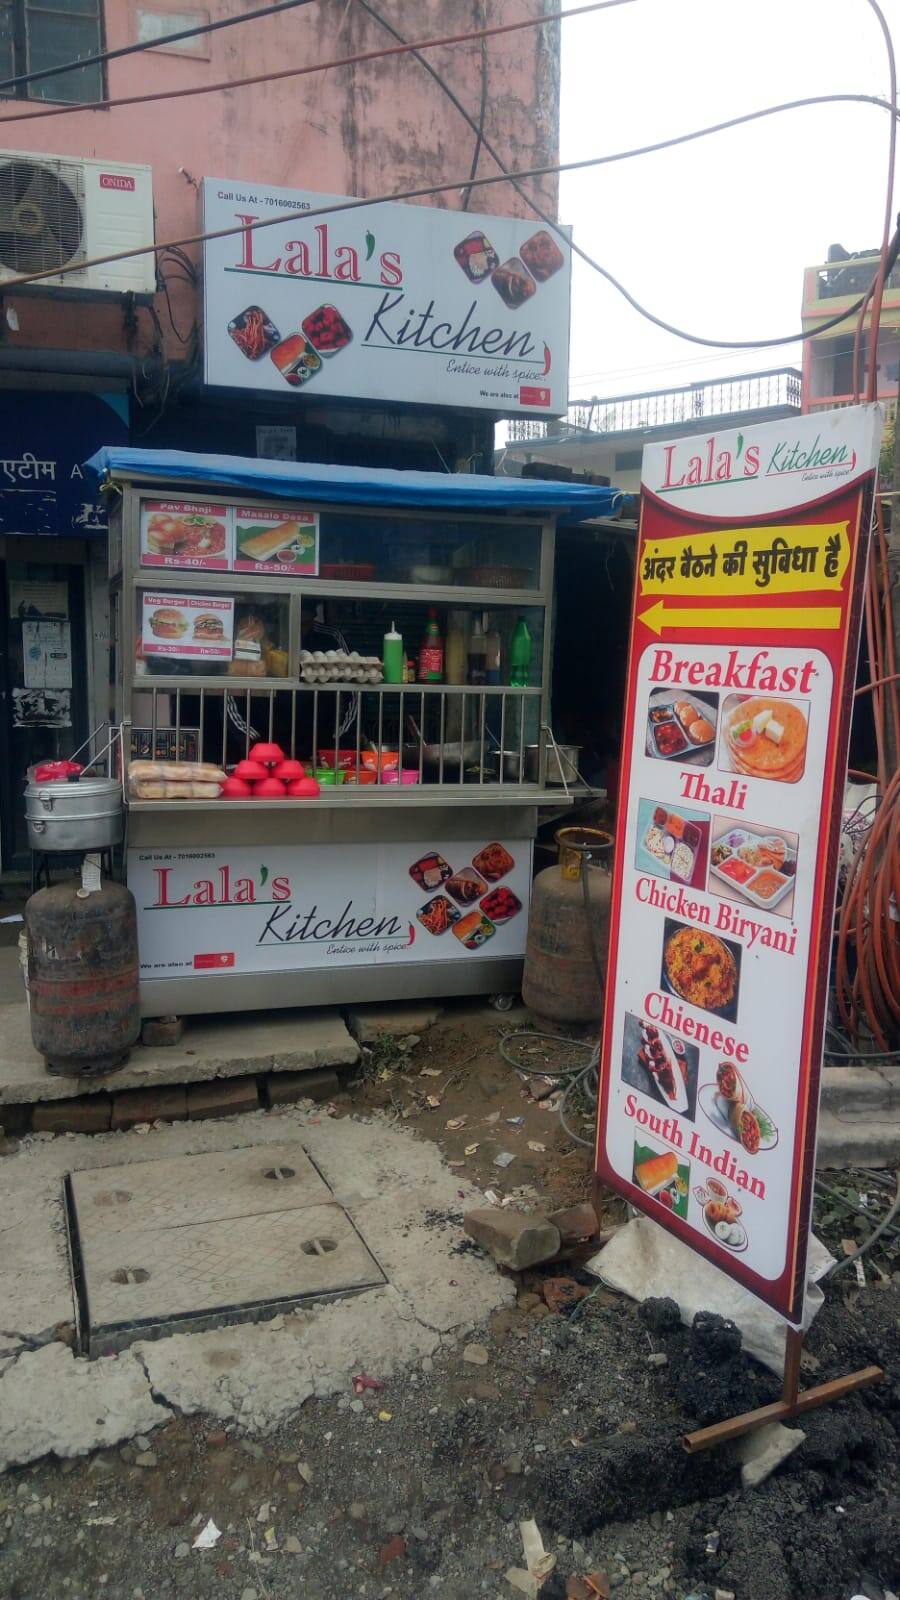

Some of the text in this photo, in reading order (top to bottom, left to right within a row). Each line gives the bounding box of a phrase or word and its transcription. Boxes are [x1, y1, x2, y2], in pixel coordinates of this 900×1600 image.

[102, 177, 135, 190] ONIDA
[217, 191, 234, 201] Call
[236, 194, 247, 202] Us
[248, 195, 258, 204] At
[234, 213, 403, 286] Lala's
[364, 292, 536, 358] Kitchen
[446, 359, 481, 376] Entice
[484, 363, 510, 378] with
[660, 433, 848, 489] Lala's Kitchen
[160, 503, 180, 511] Pav
[643, 533, 842, 588] अंदर बैठने की सुविधा है
[648, 649, 817, 694] Breakfast
[679, 771, 749, 810] Thali
[152, 863, 292, 906] Lala's
[258, 900, 402, 943] Kitchen
[635, 877, 798, 956] Chicken Biryani
[358, 941, 381, 953] with
[644, 991, 751, 1064] Chienese
[624, 1093, 767, 1201] South Indian
